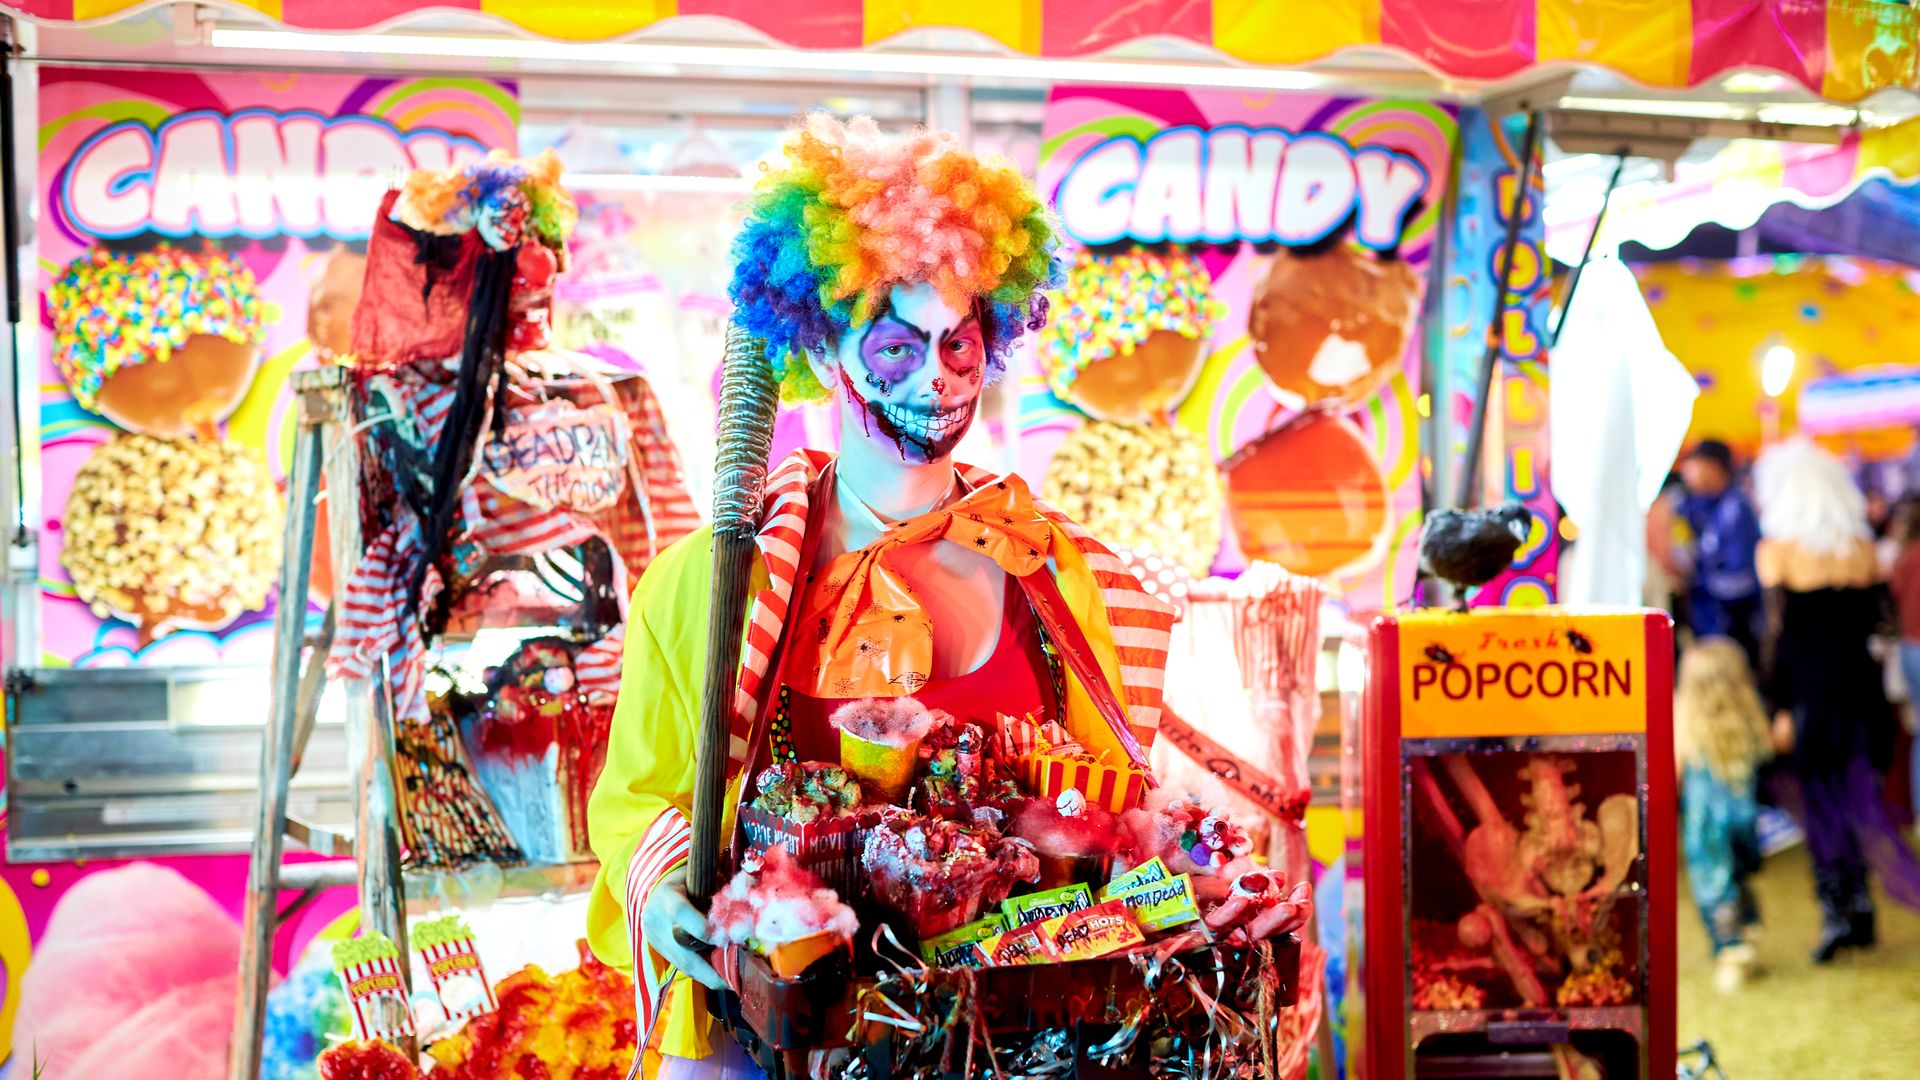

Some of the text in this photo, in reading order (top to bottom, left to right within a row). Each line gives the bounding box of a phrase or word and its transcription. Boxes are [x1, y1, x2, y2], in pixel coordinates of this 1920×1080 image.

[1058, 124, 1428, 250] CANDY
[1479, 631, 1558, 650] Fresh
[1413, 659, 1631, 701] POPCORN
[809, 832, 847, 855] MOVIE
[1089, 915, 1124, 930] HOTS
[431, 955, 477, 977] POPCORN
[352, 975, 398, 997] POPCORN
